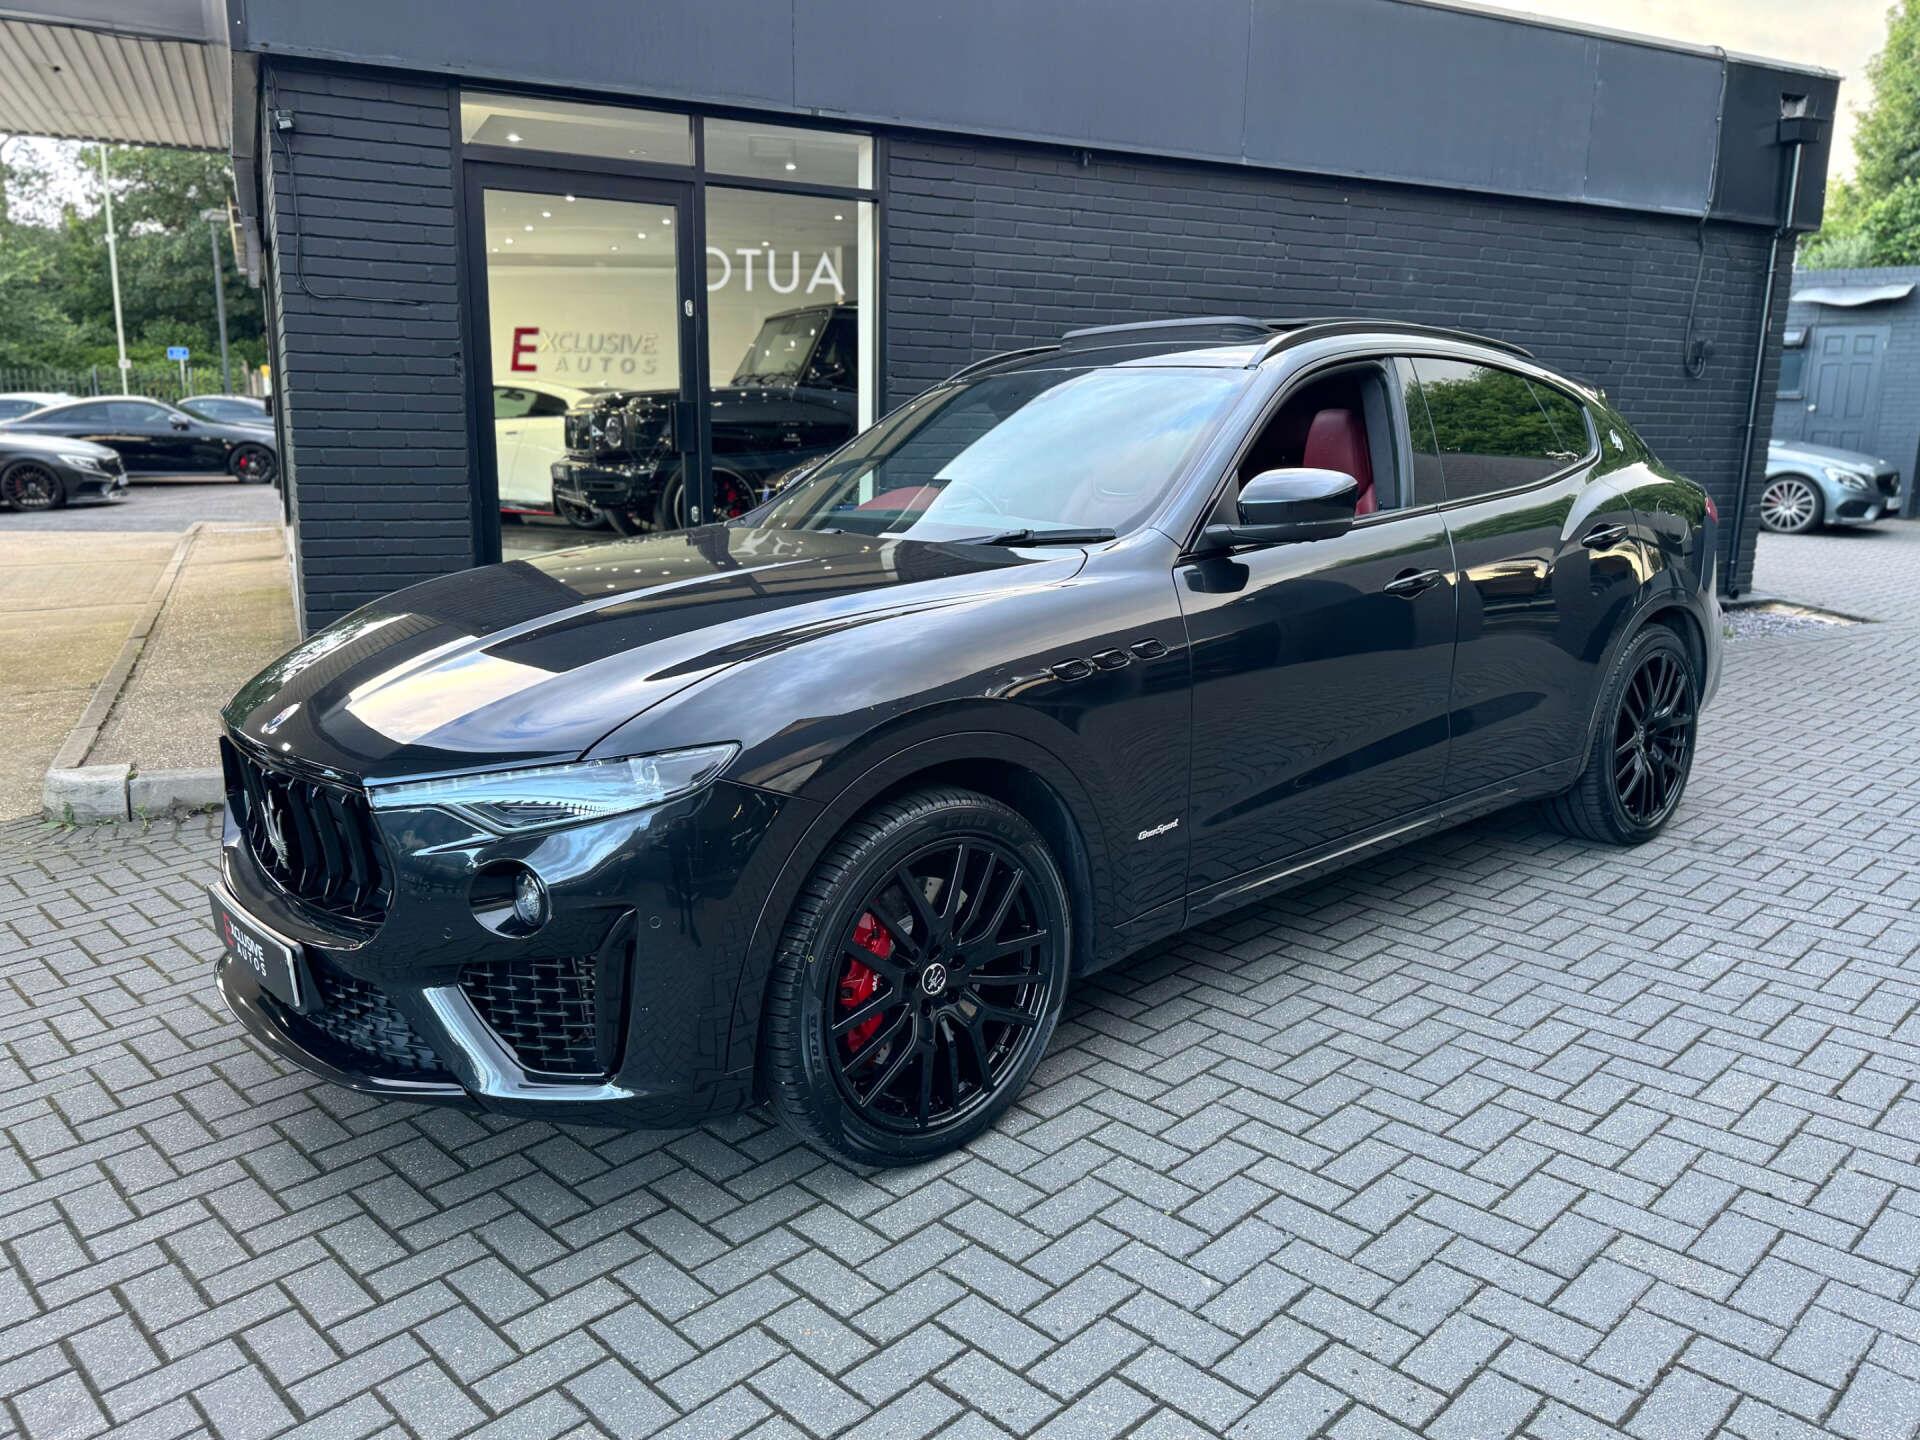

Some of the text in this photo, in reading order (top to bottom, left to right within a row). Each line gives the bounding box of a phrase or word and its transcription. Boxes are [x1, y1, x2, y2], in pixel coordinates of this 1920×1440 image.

[511, 327, 657, 372] EXCLUSIVE
[555, 356, 657, 374] AUTOS
[236, 942, 267, 977] AUTOS
